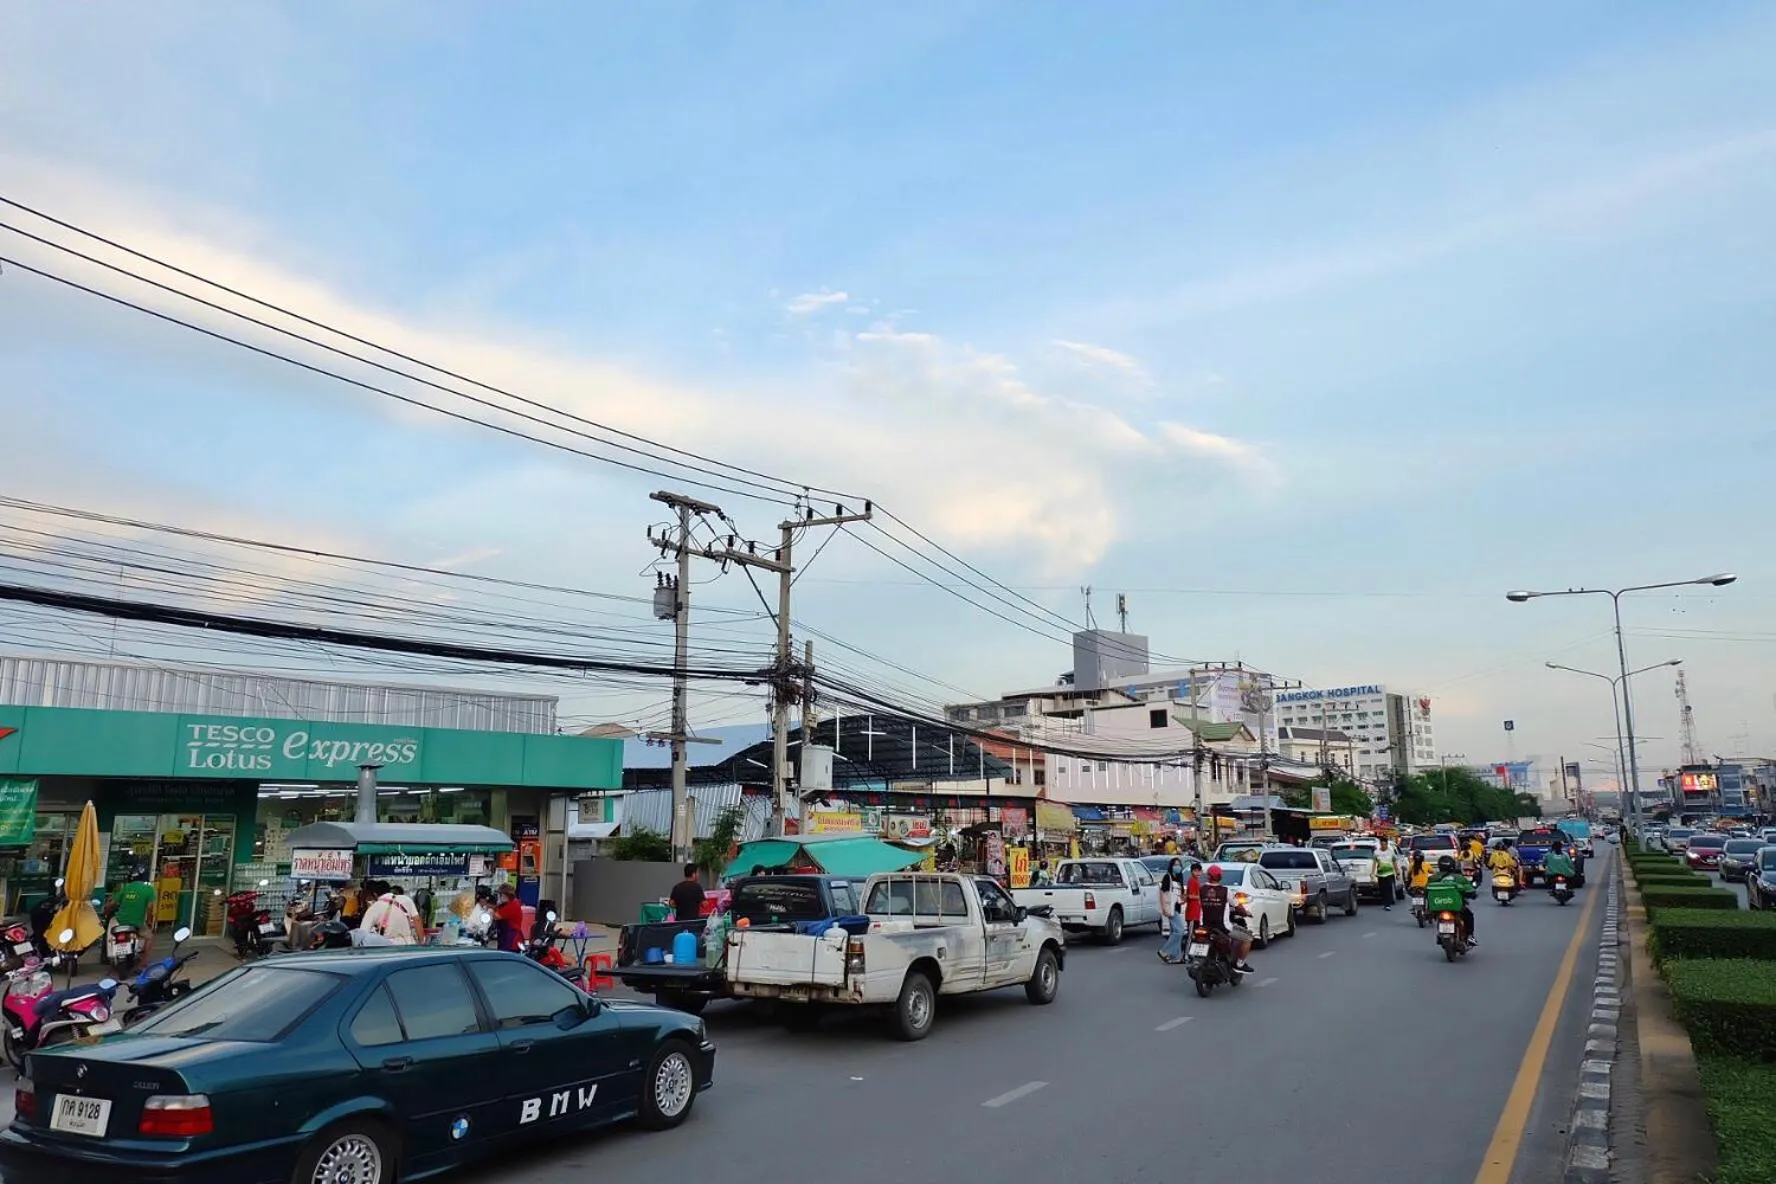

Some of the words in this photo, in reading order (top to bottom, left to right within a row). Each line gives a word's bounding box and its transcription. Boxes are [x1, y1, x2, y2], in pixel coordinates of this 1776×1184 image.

[1276, 690, 1323, 703] BANGKOK
[1328, 685, 1381, 697] HOSPITAL
[187, 724, 275, 743] TESCO
[188, 748, 272, 770] Lotus
[282, 731, 418, 768] express
[78, 1101, 101, 1120] 9128
